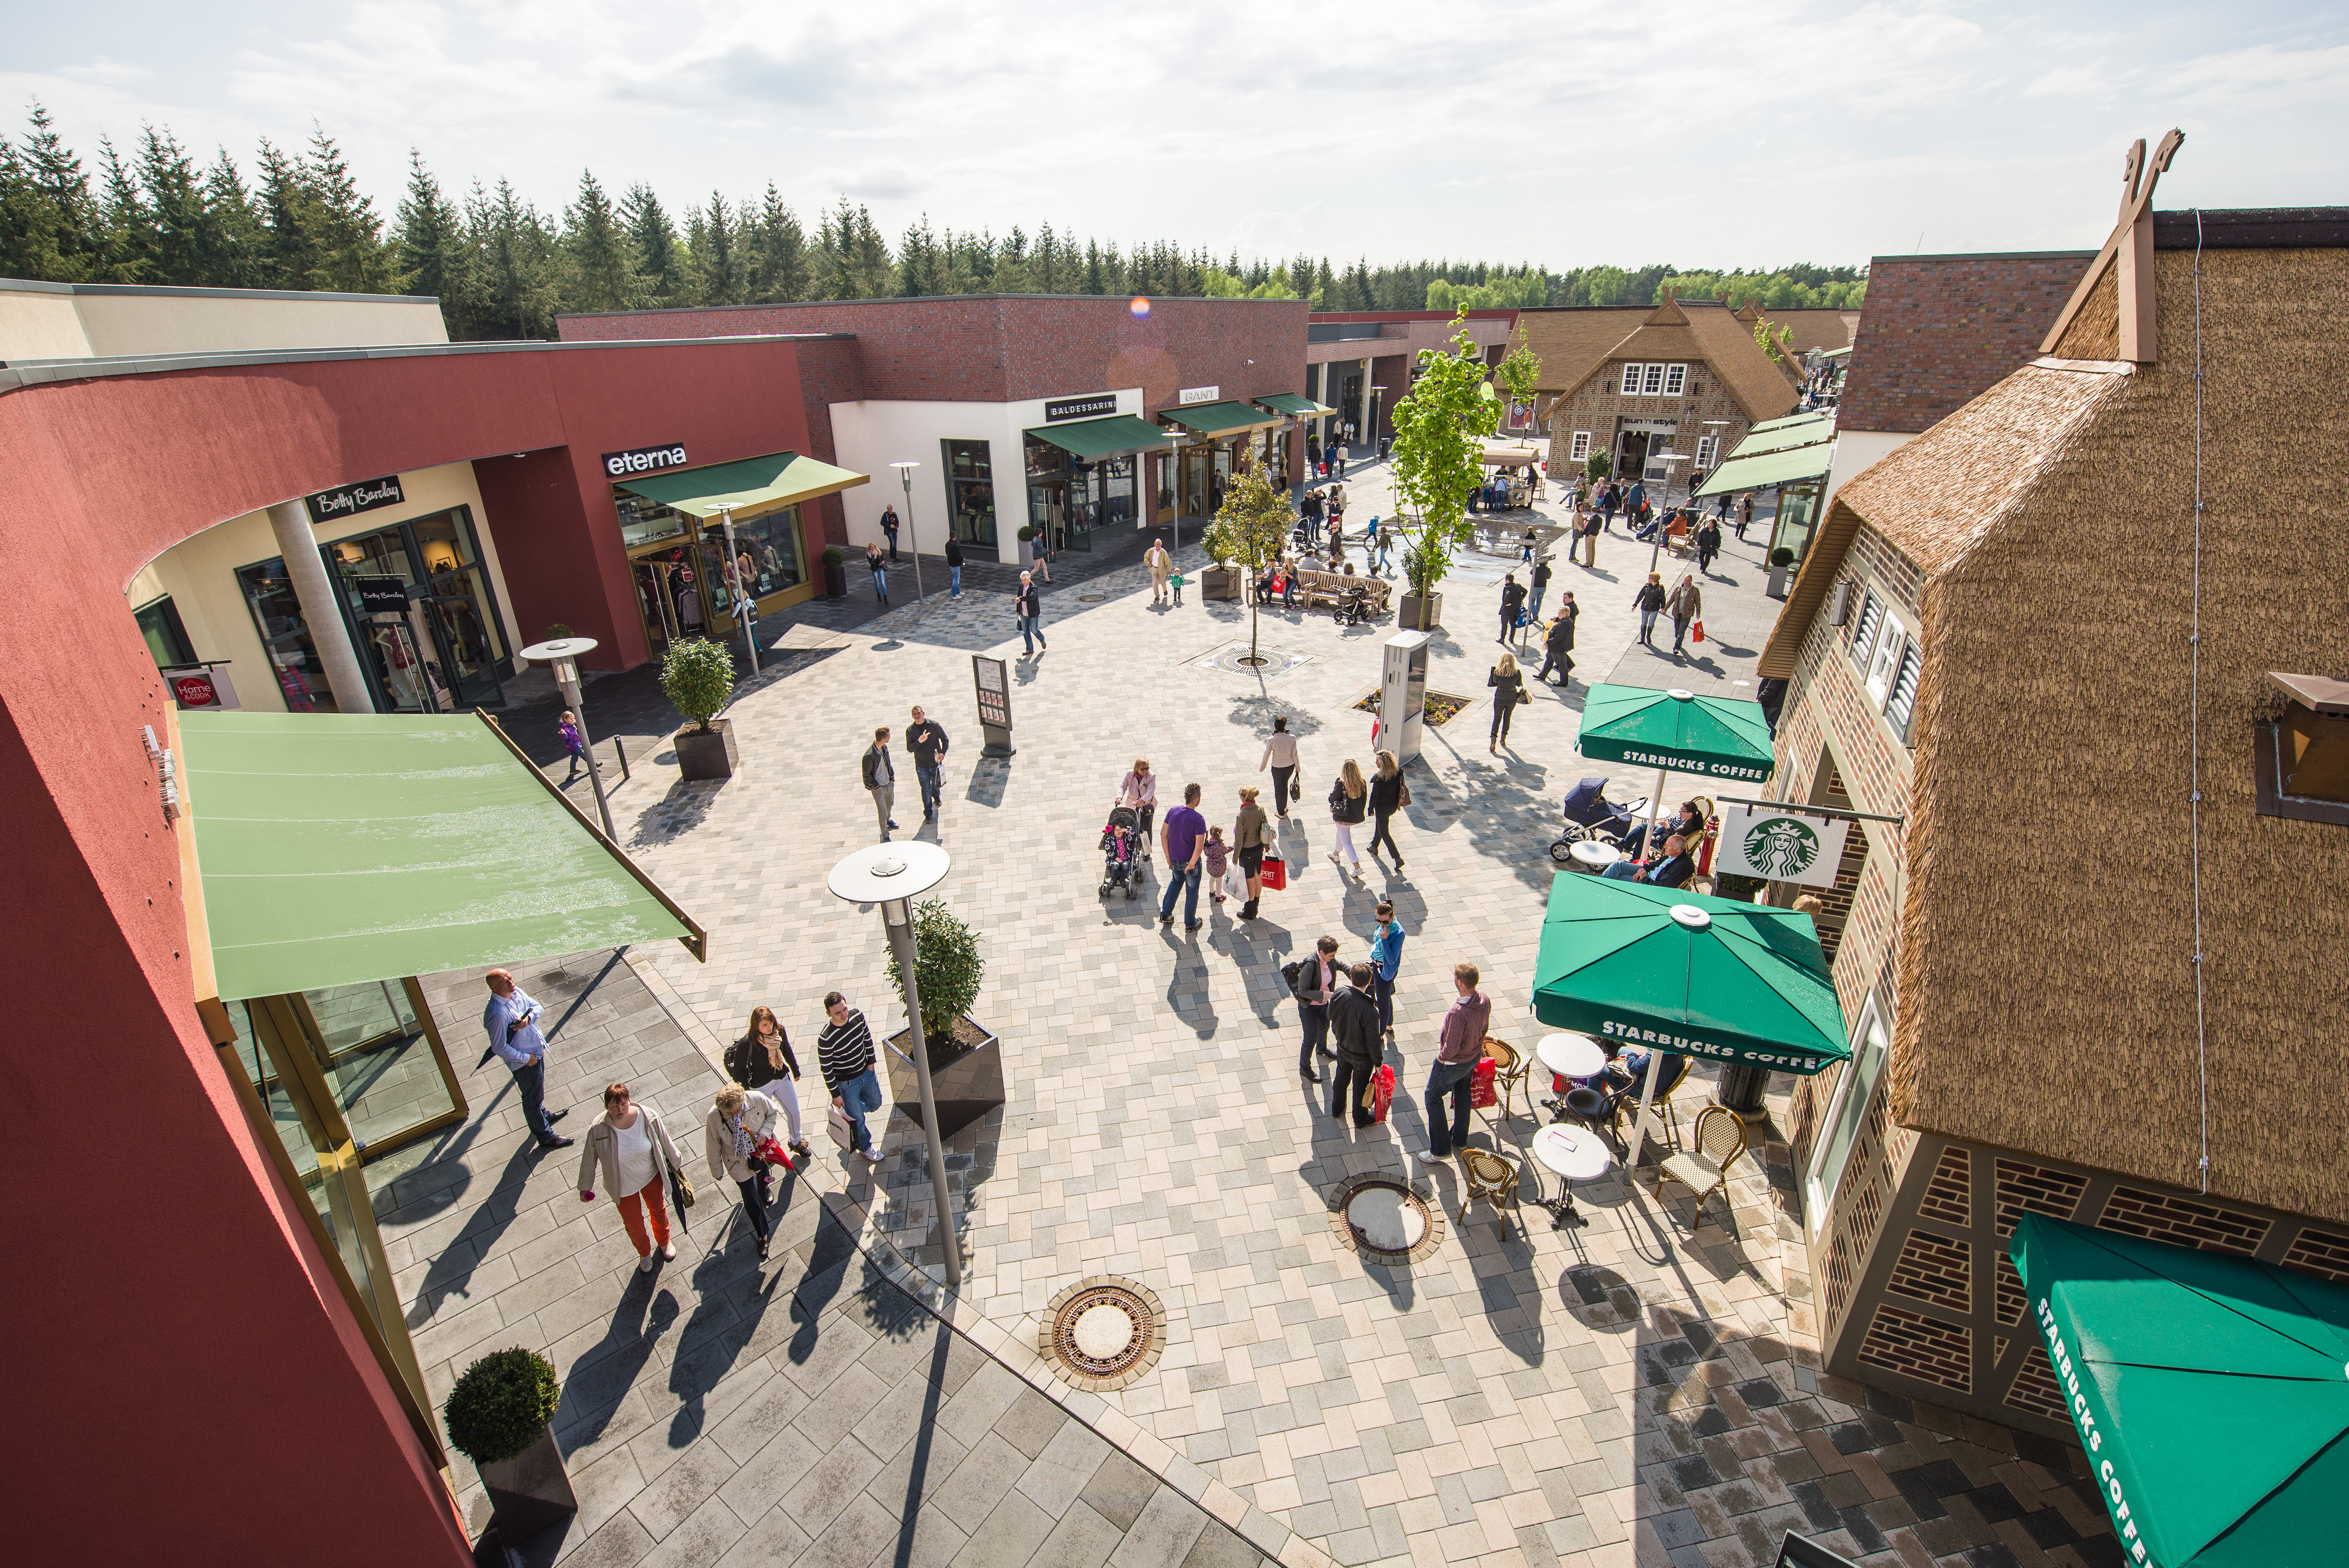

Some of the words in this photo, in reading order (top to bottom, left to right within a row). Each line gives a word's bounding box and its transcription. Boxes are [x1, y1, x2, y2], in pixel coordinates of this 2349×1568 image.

[1052, 401, 1116, 415] BALDESSARINI
[1186, 389, 1215, 401] GANT
[608, 447, 687, 475] eterna
[316, 493, 354, 513] Betty
[353, 481, 399, 505] Barclay
[380, 591, 404, 600] Barclay
[178, 685, 211, 695] Home
[1623, 751, 1705, 771] STARBUCKS
[1711, 764, 1763, 779] COFFEE
[1602, 1021, 1734, 1056] STARBUCKS
[1744, 1052, 1827, 1069] COFFE
[2038, 1297, 2101, 1452] STARBUCKS
[2100, 1460, 2154, 1568] COFFE
